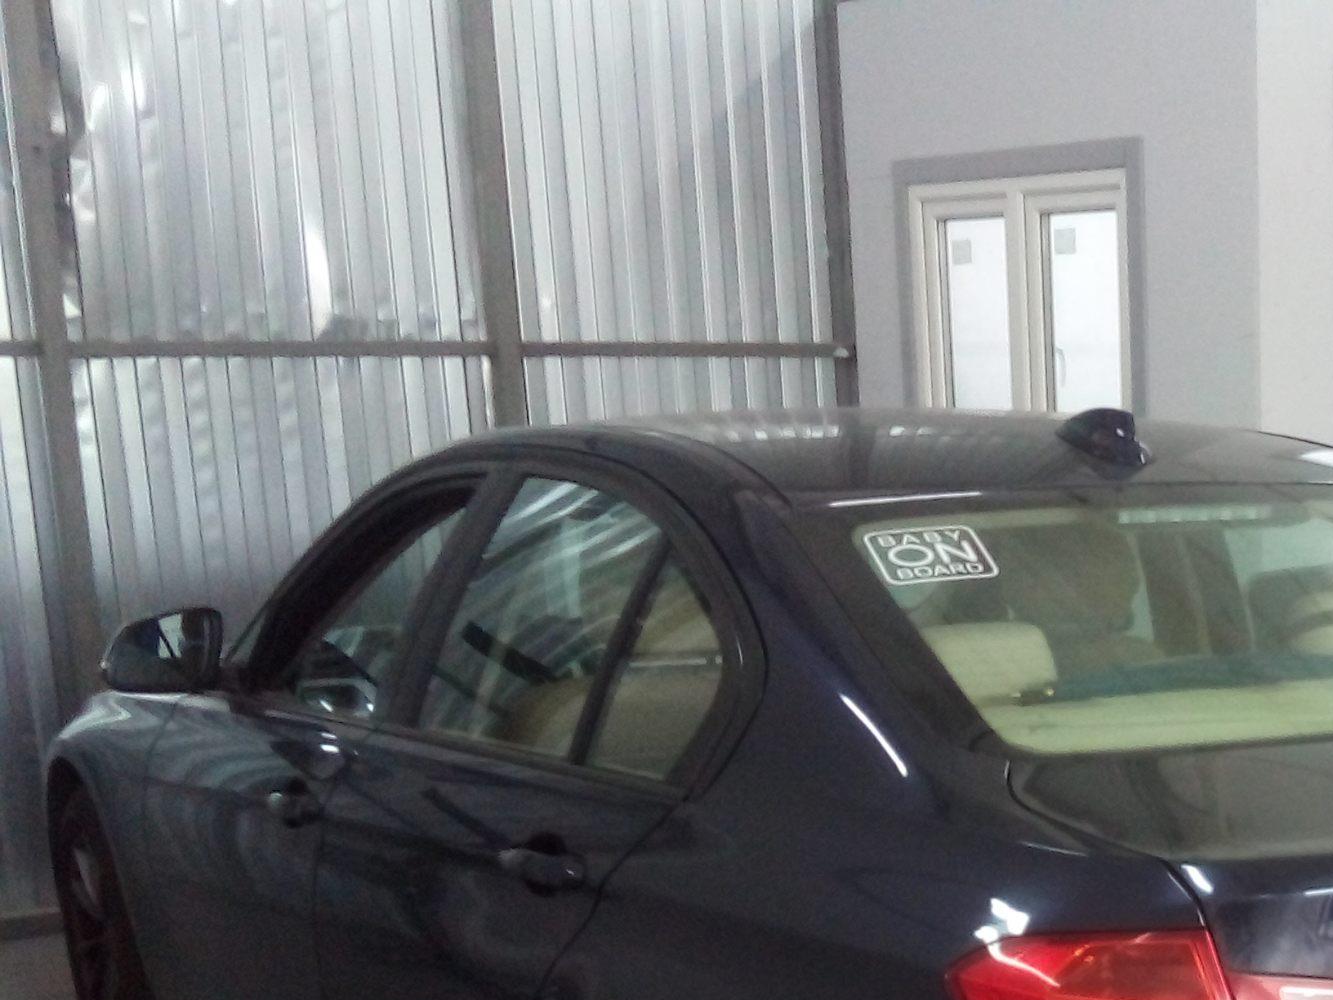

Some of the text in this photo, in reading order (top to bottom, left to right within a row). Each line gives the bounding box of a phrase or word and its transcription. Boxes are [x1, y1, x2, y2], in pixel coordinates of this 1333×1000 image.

[877, 530, 961, 548] BABY
[888, 540, 978, 568] ON
[897, 562, 985, 580] BOARD
